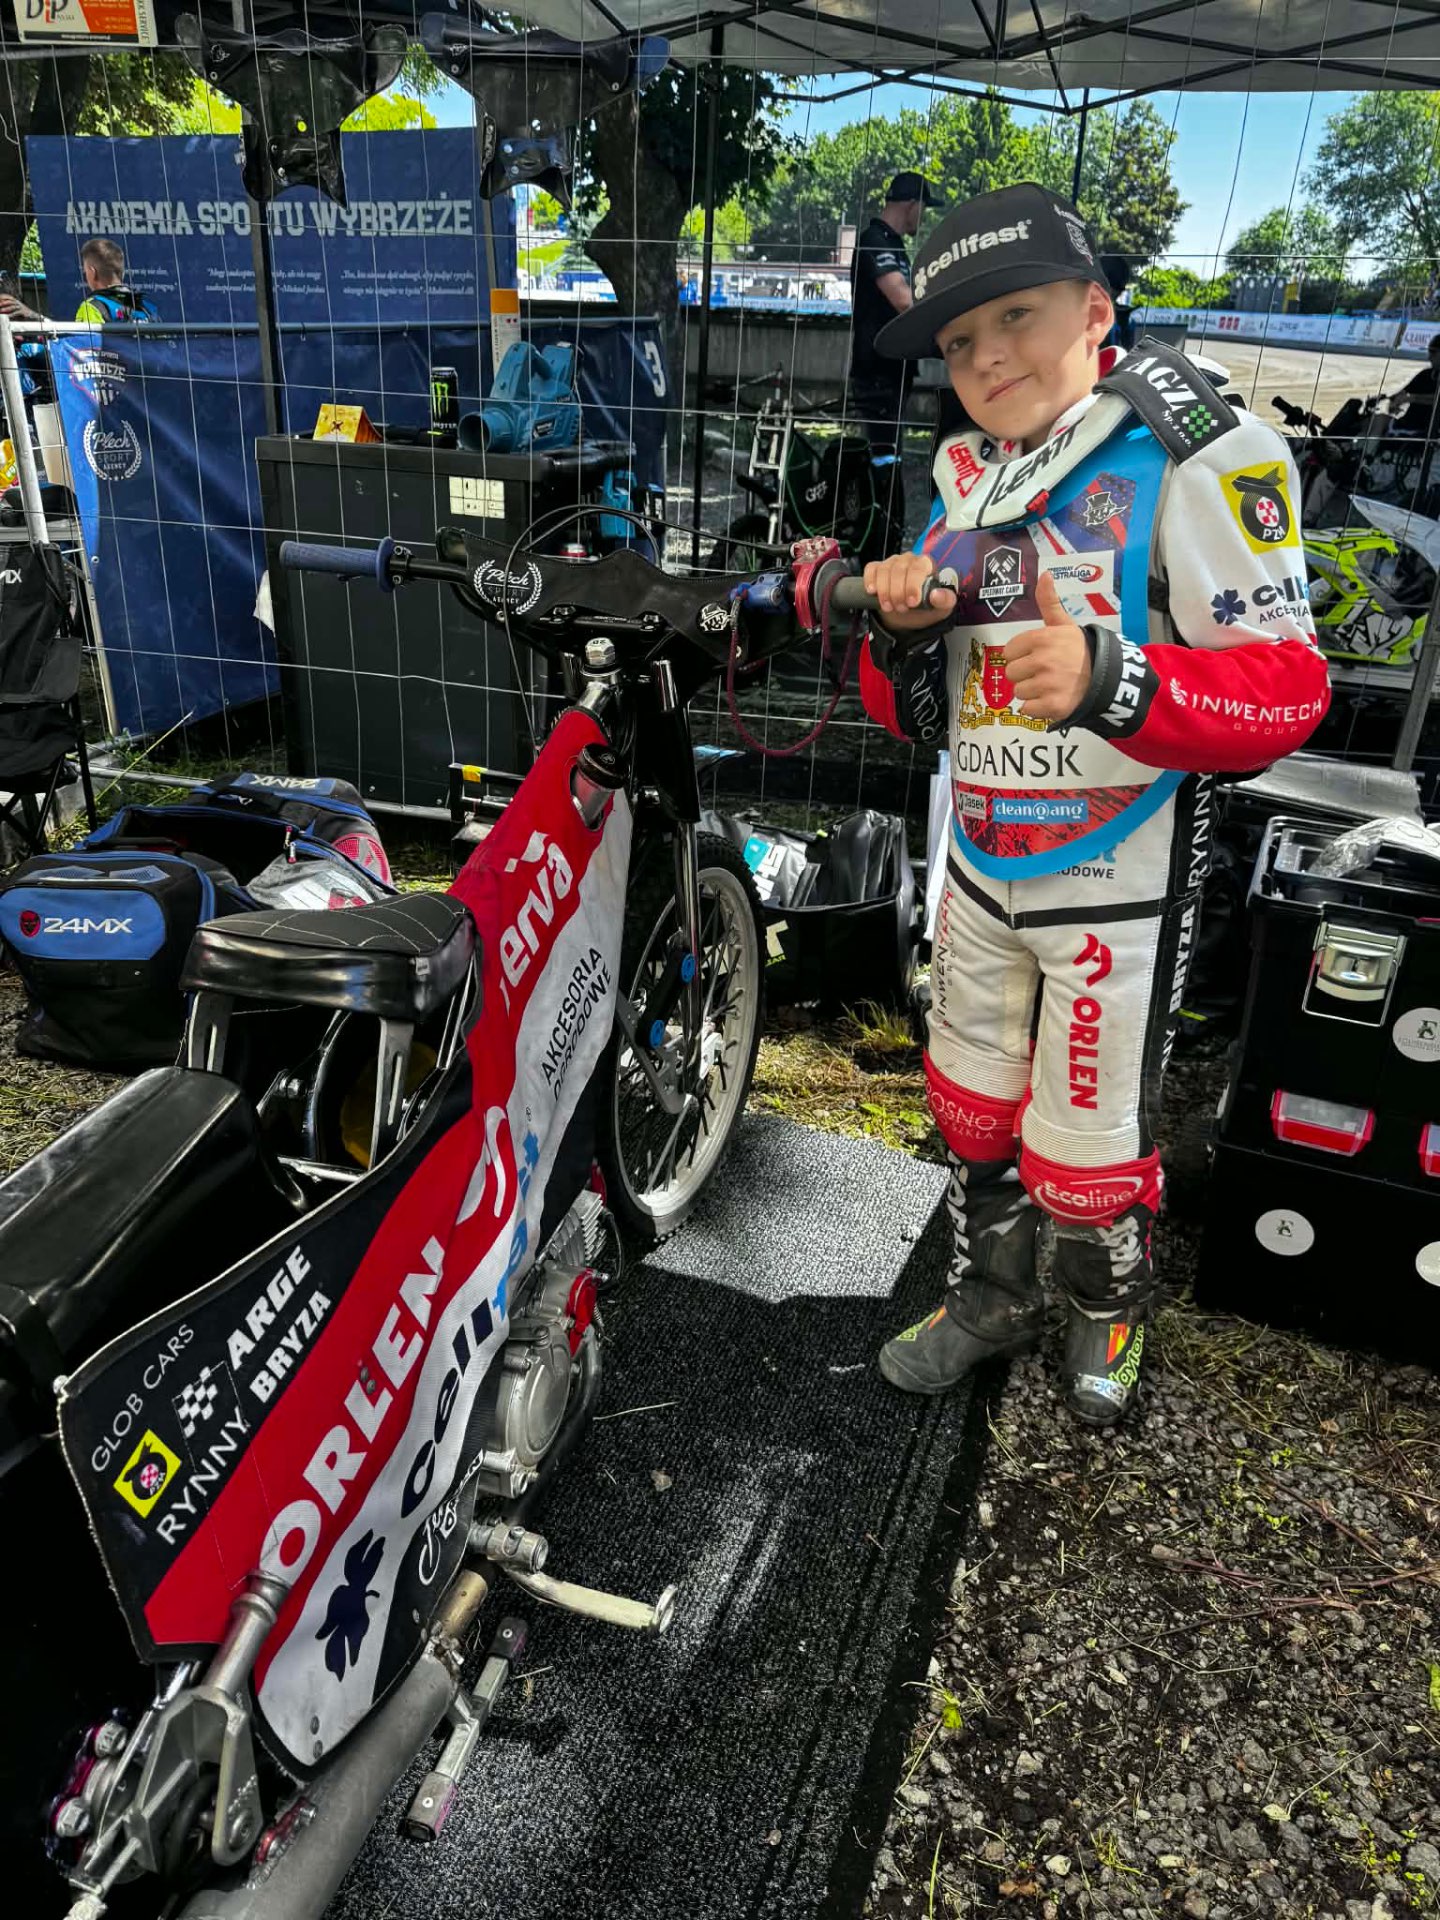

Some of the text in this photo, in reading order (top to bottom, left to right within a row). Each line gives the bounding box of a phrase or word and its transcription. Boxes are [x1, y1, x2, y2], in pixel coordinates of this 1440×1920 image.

[66, 191, 473, 236] AKADEMIA SPOTU WYBRZEŻE
[927, 219, 1030, 278] cellfast
[1122, 357, 1199, 412] AGZ
[92, 432, 131, 451] Plech
[989, 416, 1086, 506] LEATT
[1052, 569, 1092, 580] STRALIGA
[1258, 607, 1311, 625] AKCERIA
[1191, 693, 1323, 723] INWENTECH
[1233, 723, 1298, 736] GROUP
[957, 738, 1084, 778] GDAŃSK
[1187, 772, 1213, 889] RYNNY
[43, 917, 133, 934] 24MX
[541, 947, 602, 1086] AKCESORIA
[1069, 996, 1103, 1111] ORLEN
[1044, 1181, 1134, 1208] Ecoline
[226, 1245, 311, 1371] ARGE
[249, 1290, 331, 1404] BRYZA
[91, 1324, 195, 1472] GLOB CARS
[259, 1235, 446, 1589] ORLEN
[155, 1405, 251, 1546] RYNNY
